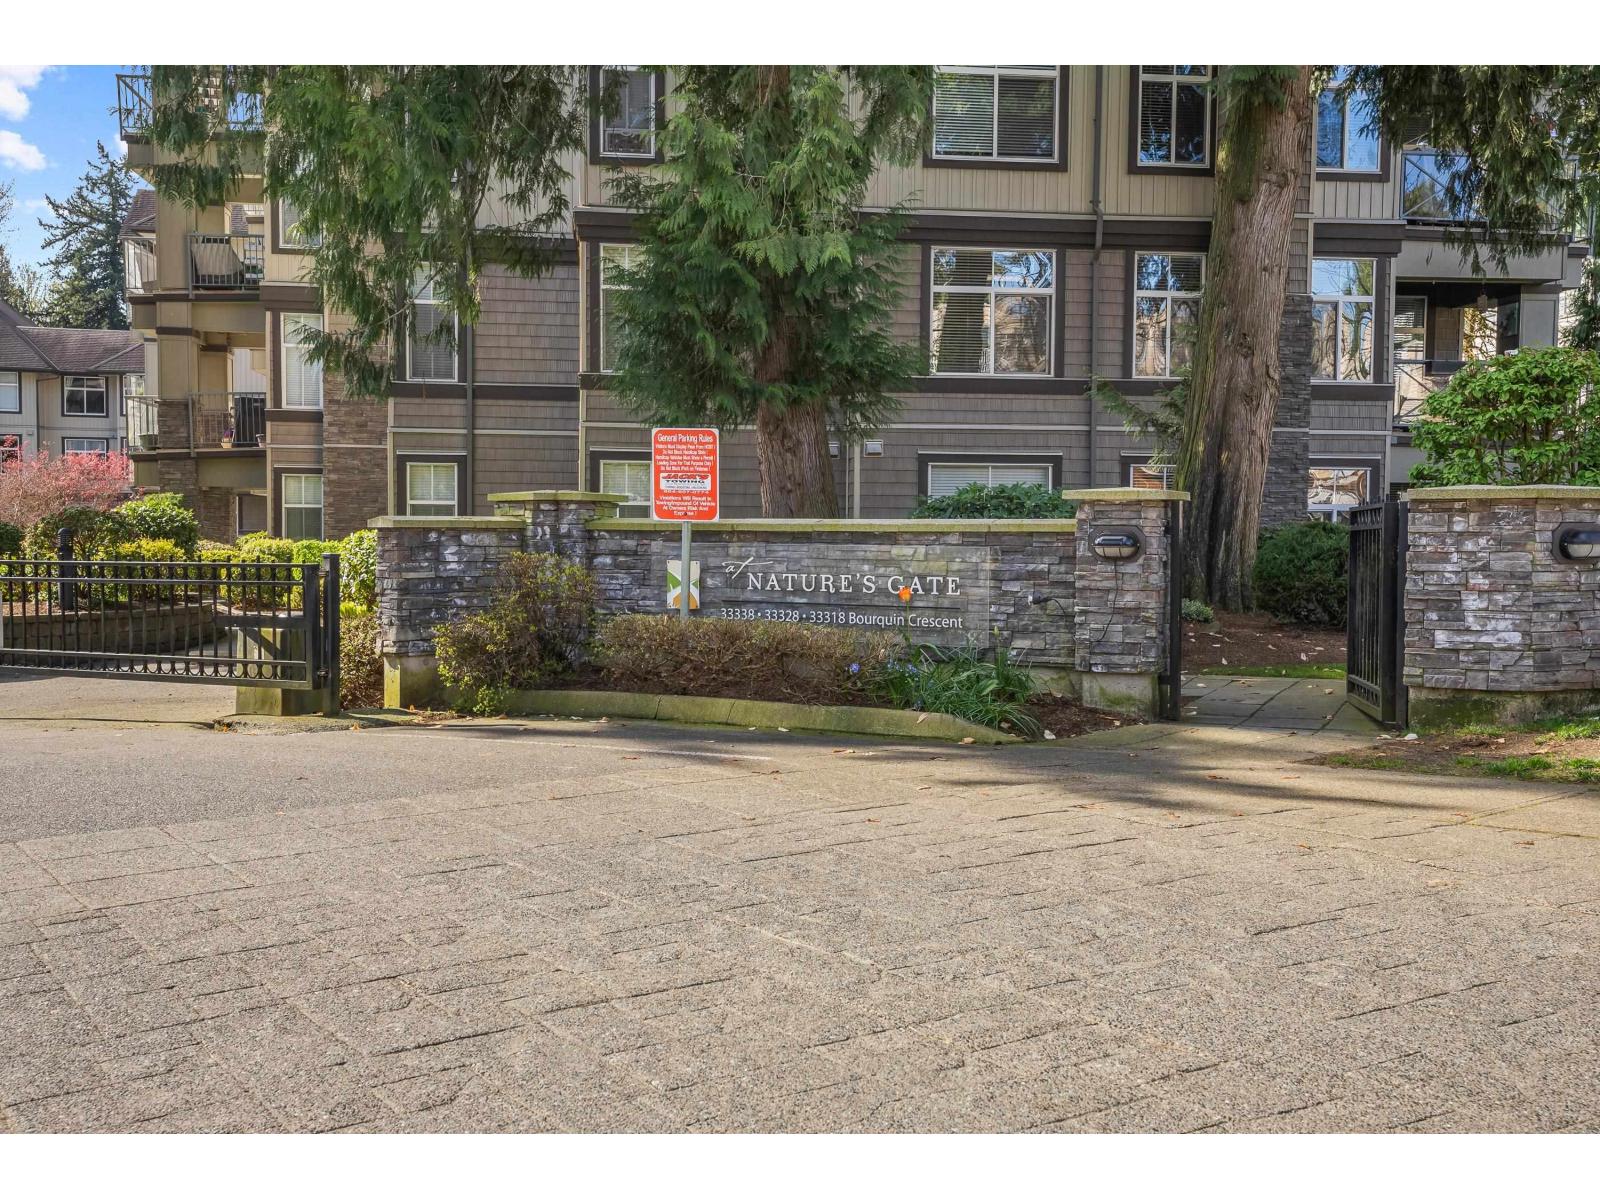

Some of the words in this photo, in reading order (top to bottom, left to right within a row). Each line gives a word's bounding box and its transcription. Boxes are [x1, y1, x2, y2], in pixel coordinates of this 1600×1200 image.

[658, 434, 677, 443] General
[678, 434, 698, 443] Parking
[698, 434, 713, 443] Rules
[722, 556, 774, 579] at
[747, 572, 876, 594] NATURE'S
[888, 576, 960, 596] GATE
[720, 608, 754, 620] 33338
[764, 610, 800, 622] 33328
[810, 611, 846, 624] 33318
[848, 612, 904, 628] Bourquin
[908, 614, 963, 628] Crescent
